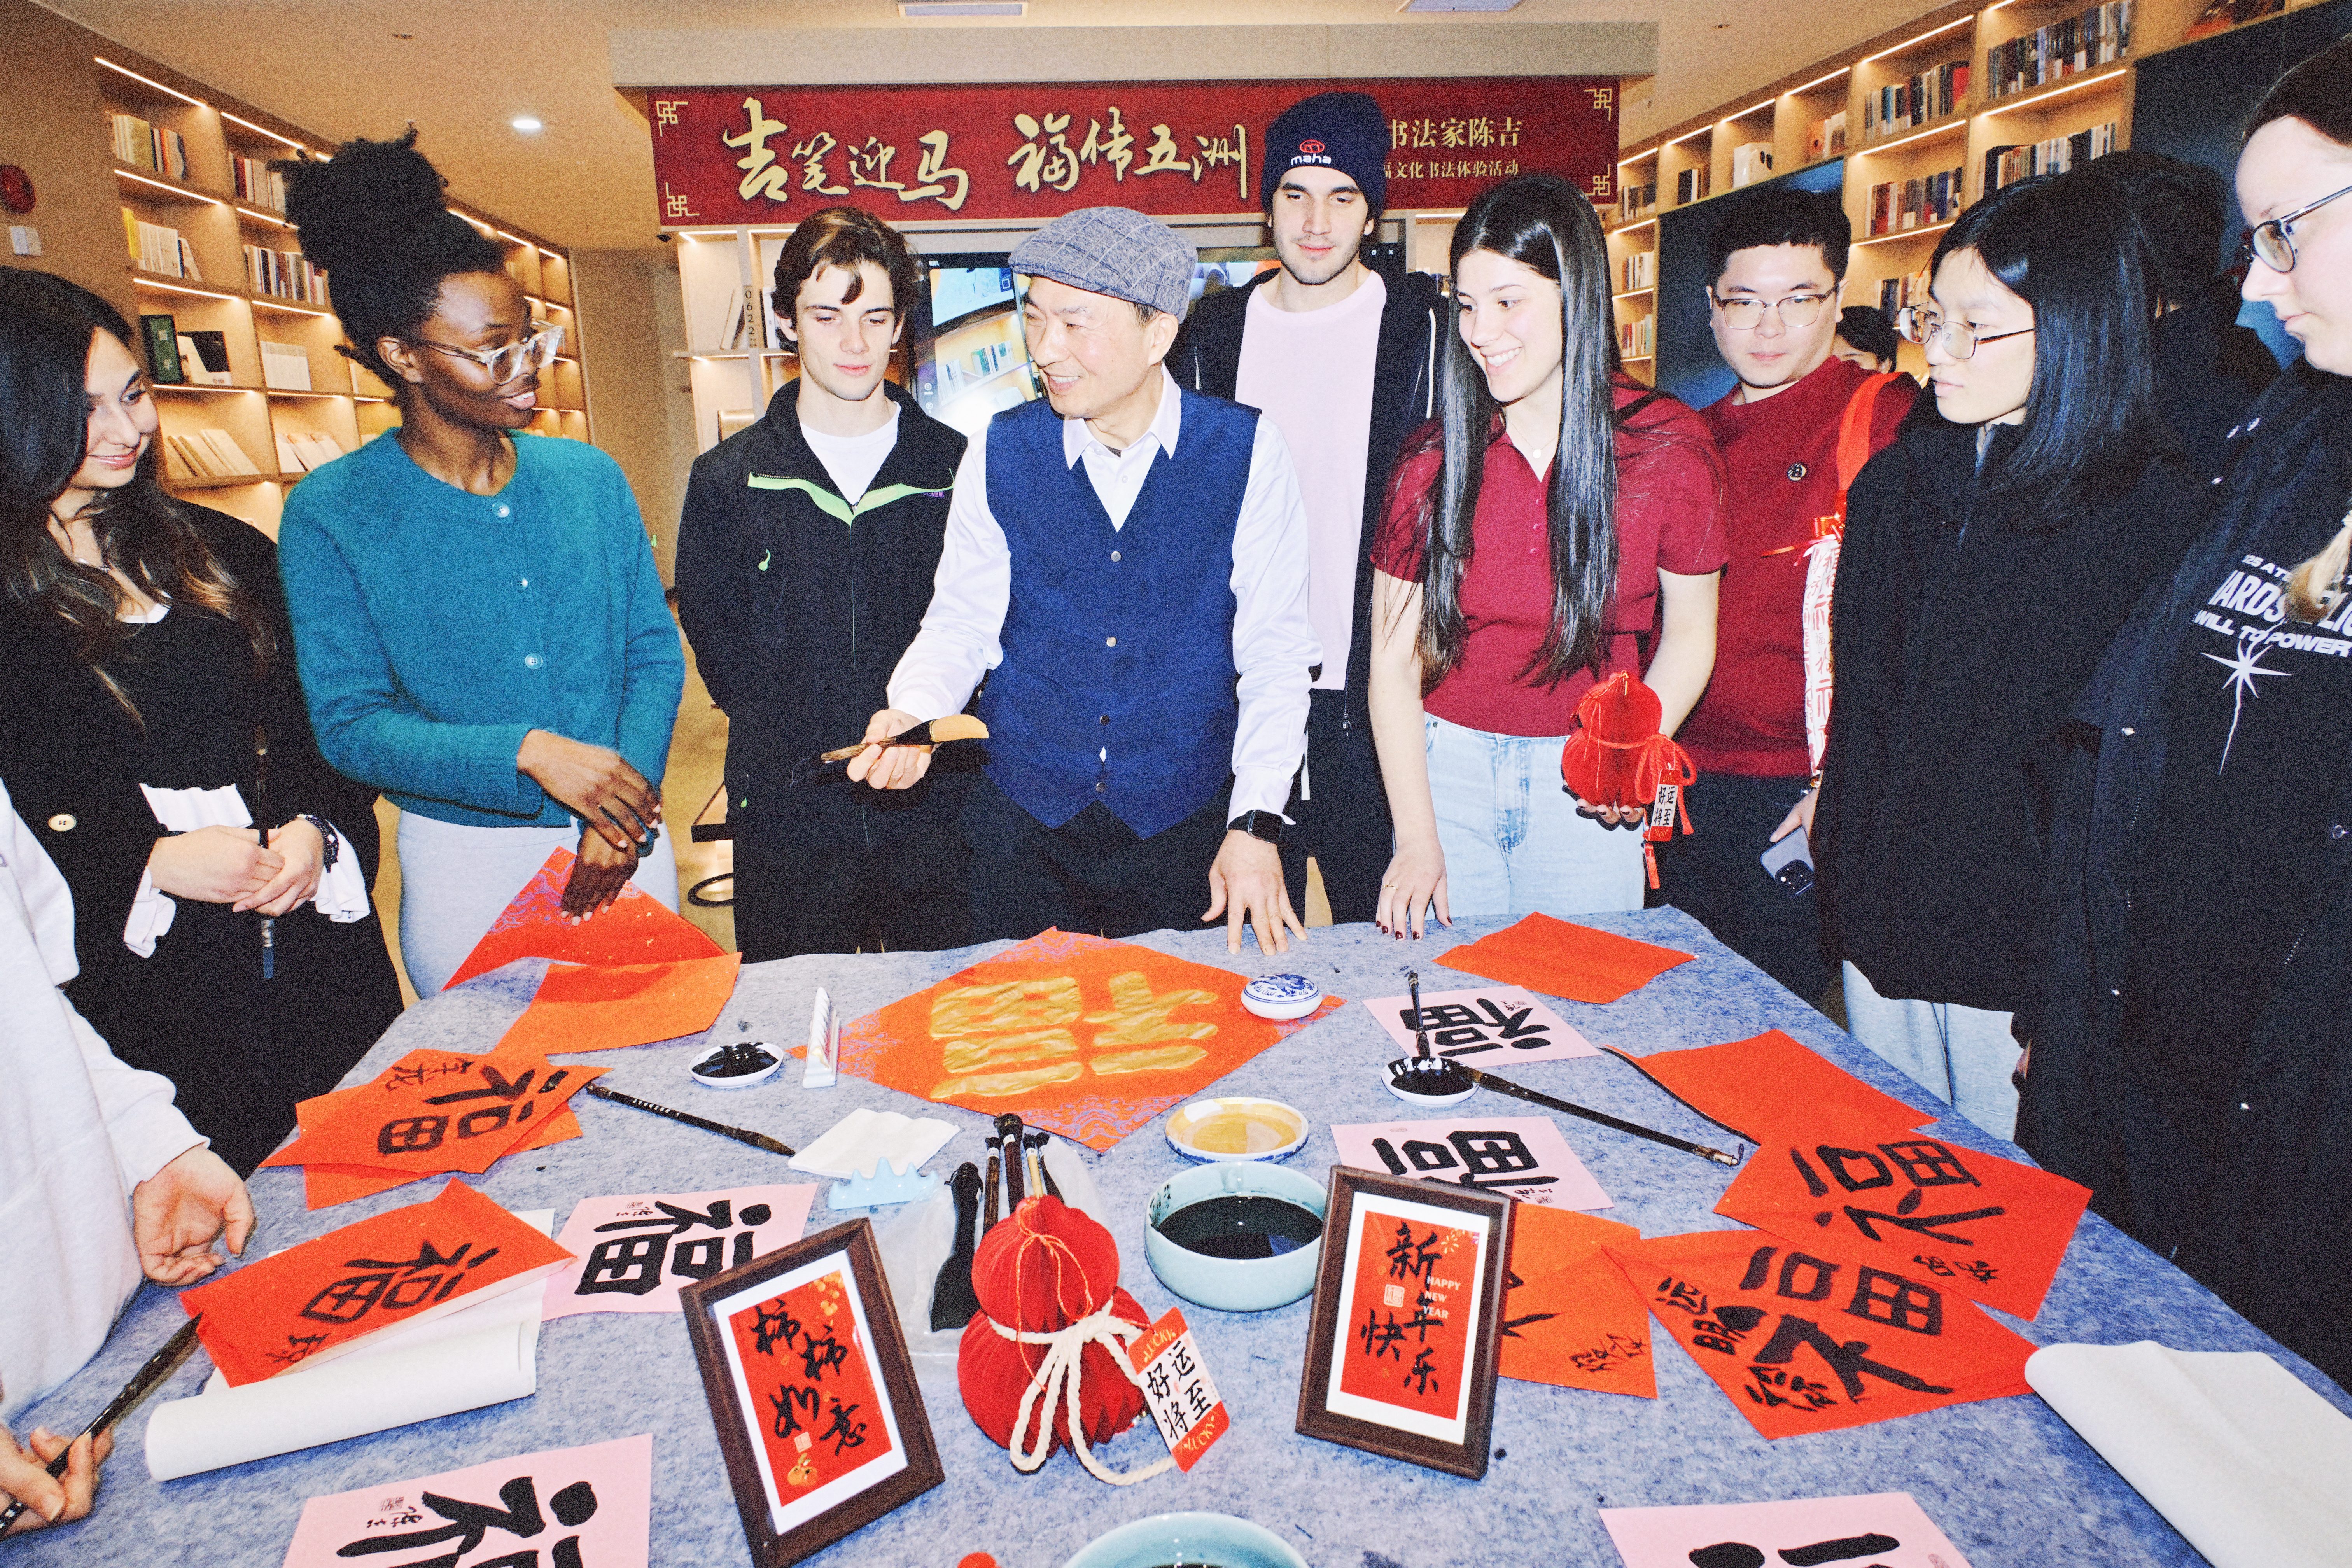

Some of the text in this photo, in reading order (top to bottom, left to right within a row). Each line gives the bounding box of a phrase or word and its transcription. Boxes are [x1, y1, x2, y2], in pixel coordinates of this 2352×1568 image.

[1387, 117, 1522, 149] 书法家陈吉
[1291, 153, 1332, 166] maha
[1430, 159, 1518, 178] 书法体验活动
[2194, 610, 2352, 657] WILL TO POWER
[1658, 786, 1675, 804] 好运
[1654, 808, 1672, 826] 将至
[1399, 998, 1551, 1057] 福
[378, 1064, 569, 1157] 福
[1790, 1140, 2007, 1246] 福
[574, 1200, 771, 1295] 福
[300, 1239, 500, 1323] 福
[1425, 1290, 1447, 1302] NEW
[1427, 1276, 1461, 1290] HAPPY
[1423, 1305, 1449, 1319] YEAR
[1714, 1246, 1955, 1404] 福
[1144, 1329, 1172, 1360] LUCKY
[1187, 1423, 1214, 1450] LUCKY
